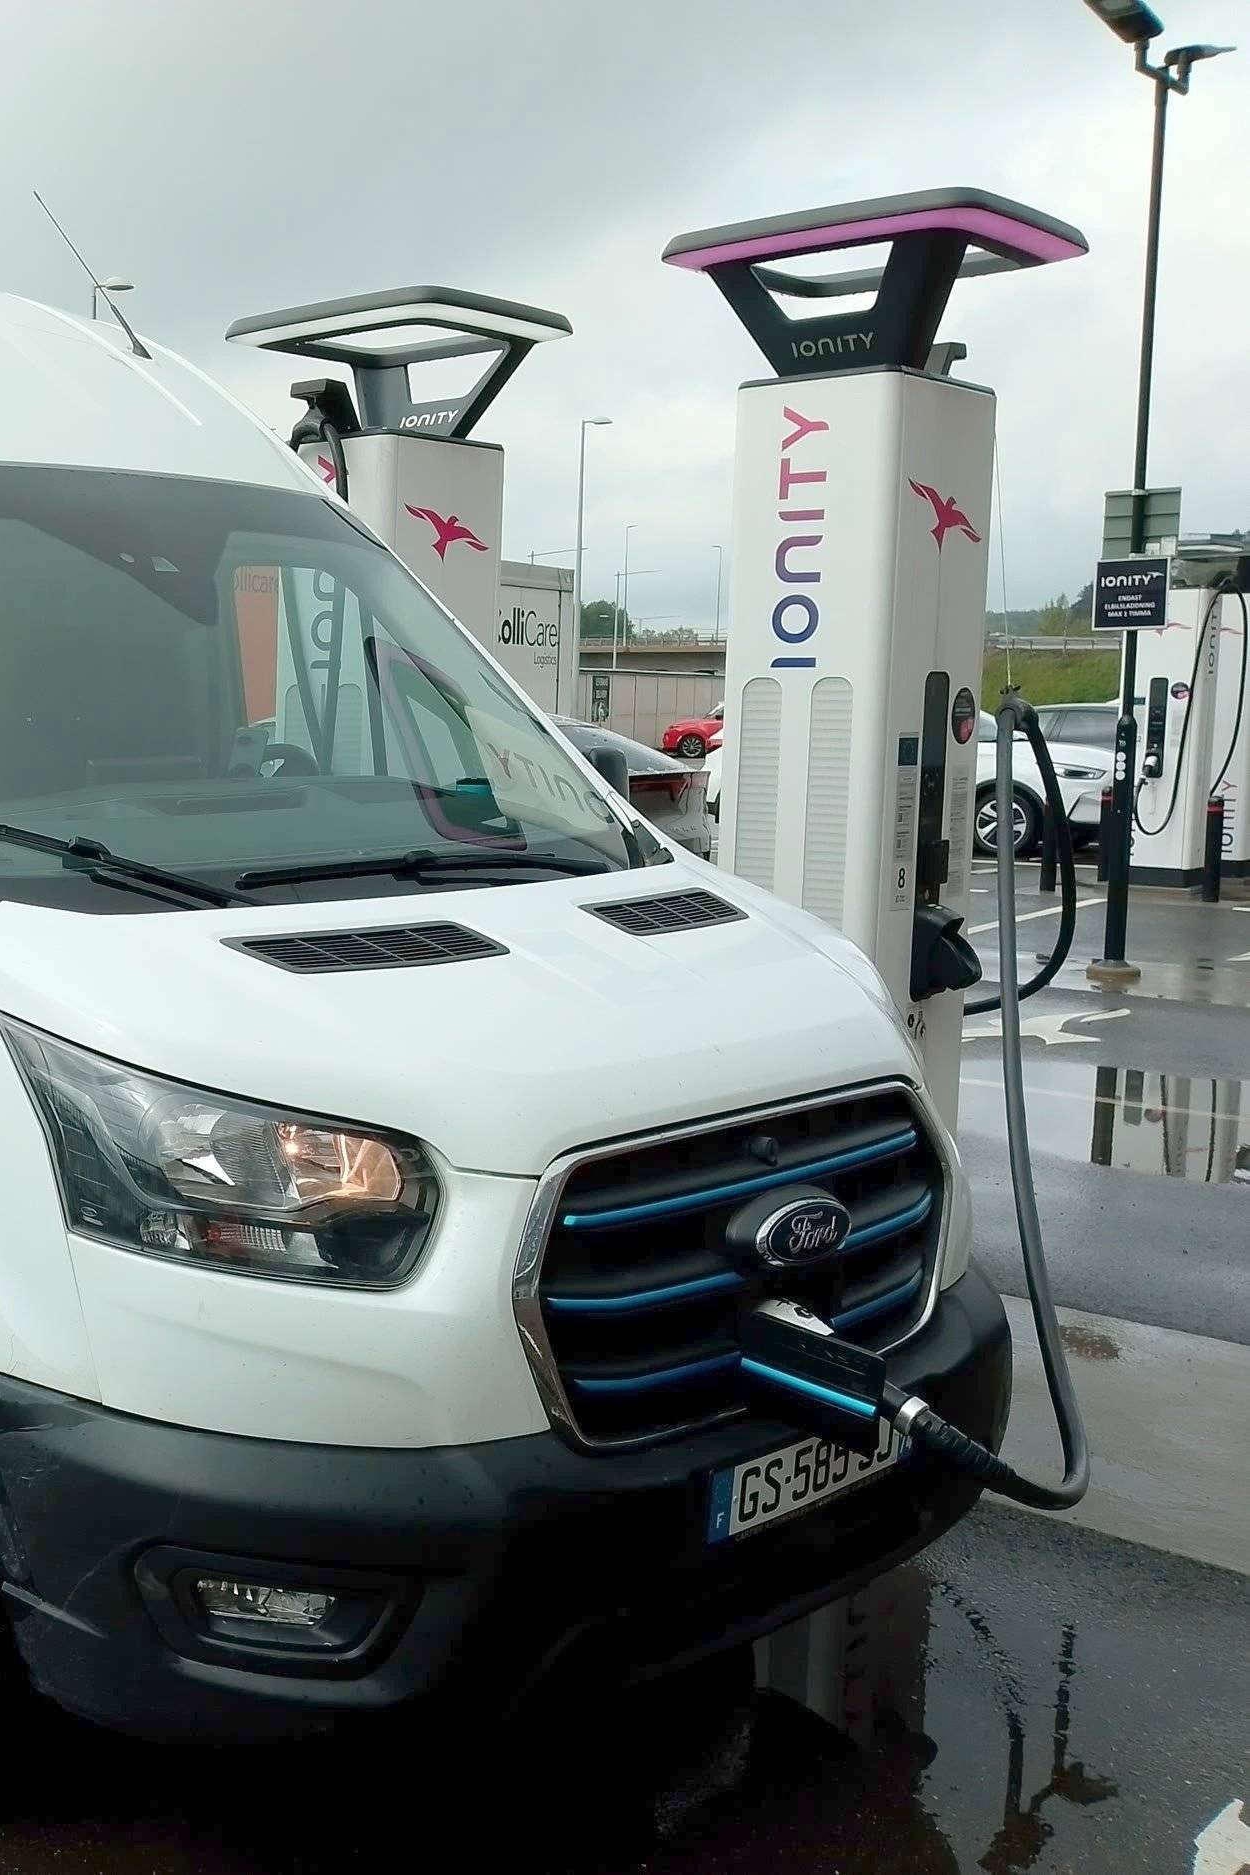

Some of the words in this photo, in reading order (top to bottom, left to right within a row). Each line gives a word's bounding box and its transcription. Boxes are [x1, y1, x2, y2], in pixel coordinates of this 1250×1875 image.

[791, 332, 873, 358] IONITY
[399, 409, 460, 429] IONITY
[770, 405, 830, 668] IONITY
[1101, 574, 1151, 588] IONITY
[1118, 594, 1142, 602] ENDAST
[498, 607, 558, 647] olliCare
[1208, 600, 1218, 674] IONIT
[533, 652, 557, 669] Logistics
[897, 867, 907, 889] 8
[788, 1210, 839, 1254] Ford
[716, 1511, 726, 1529] F
